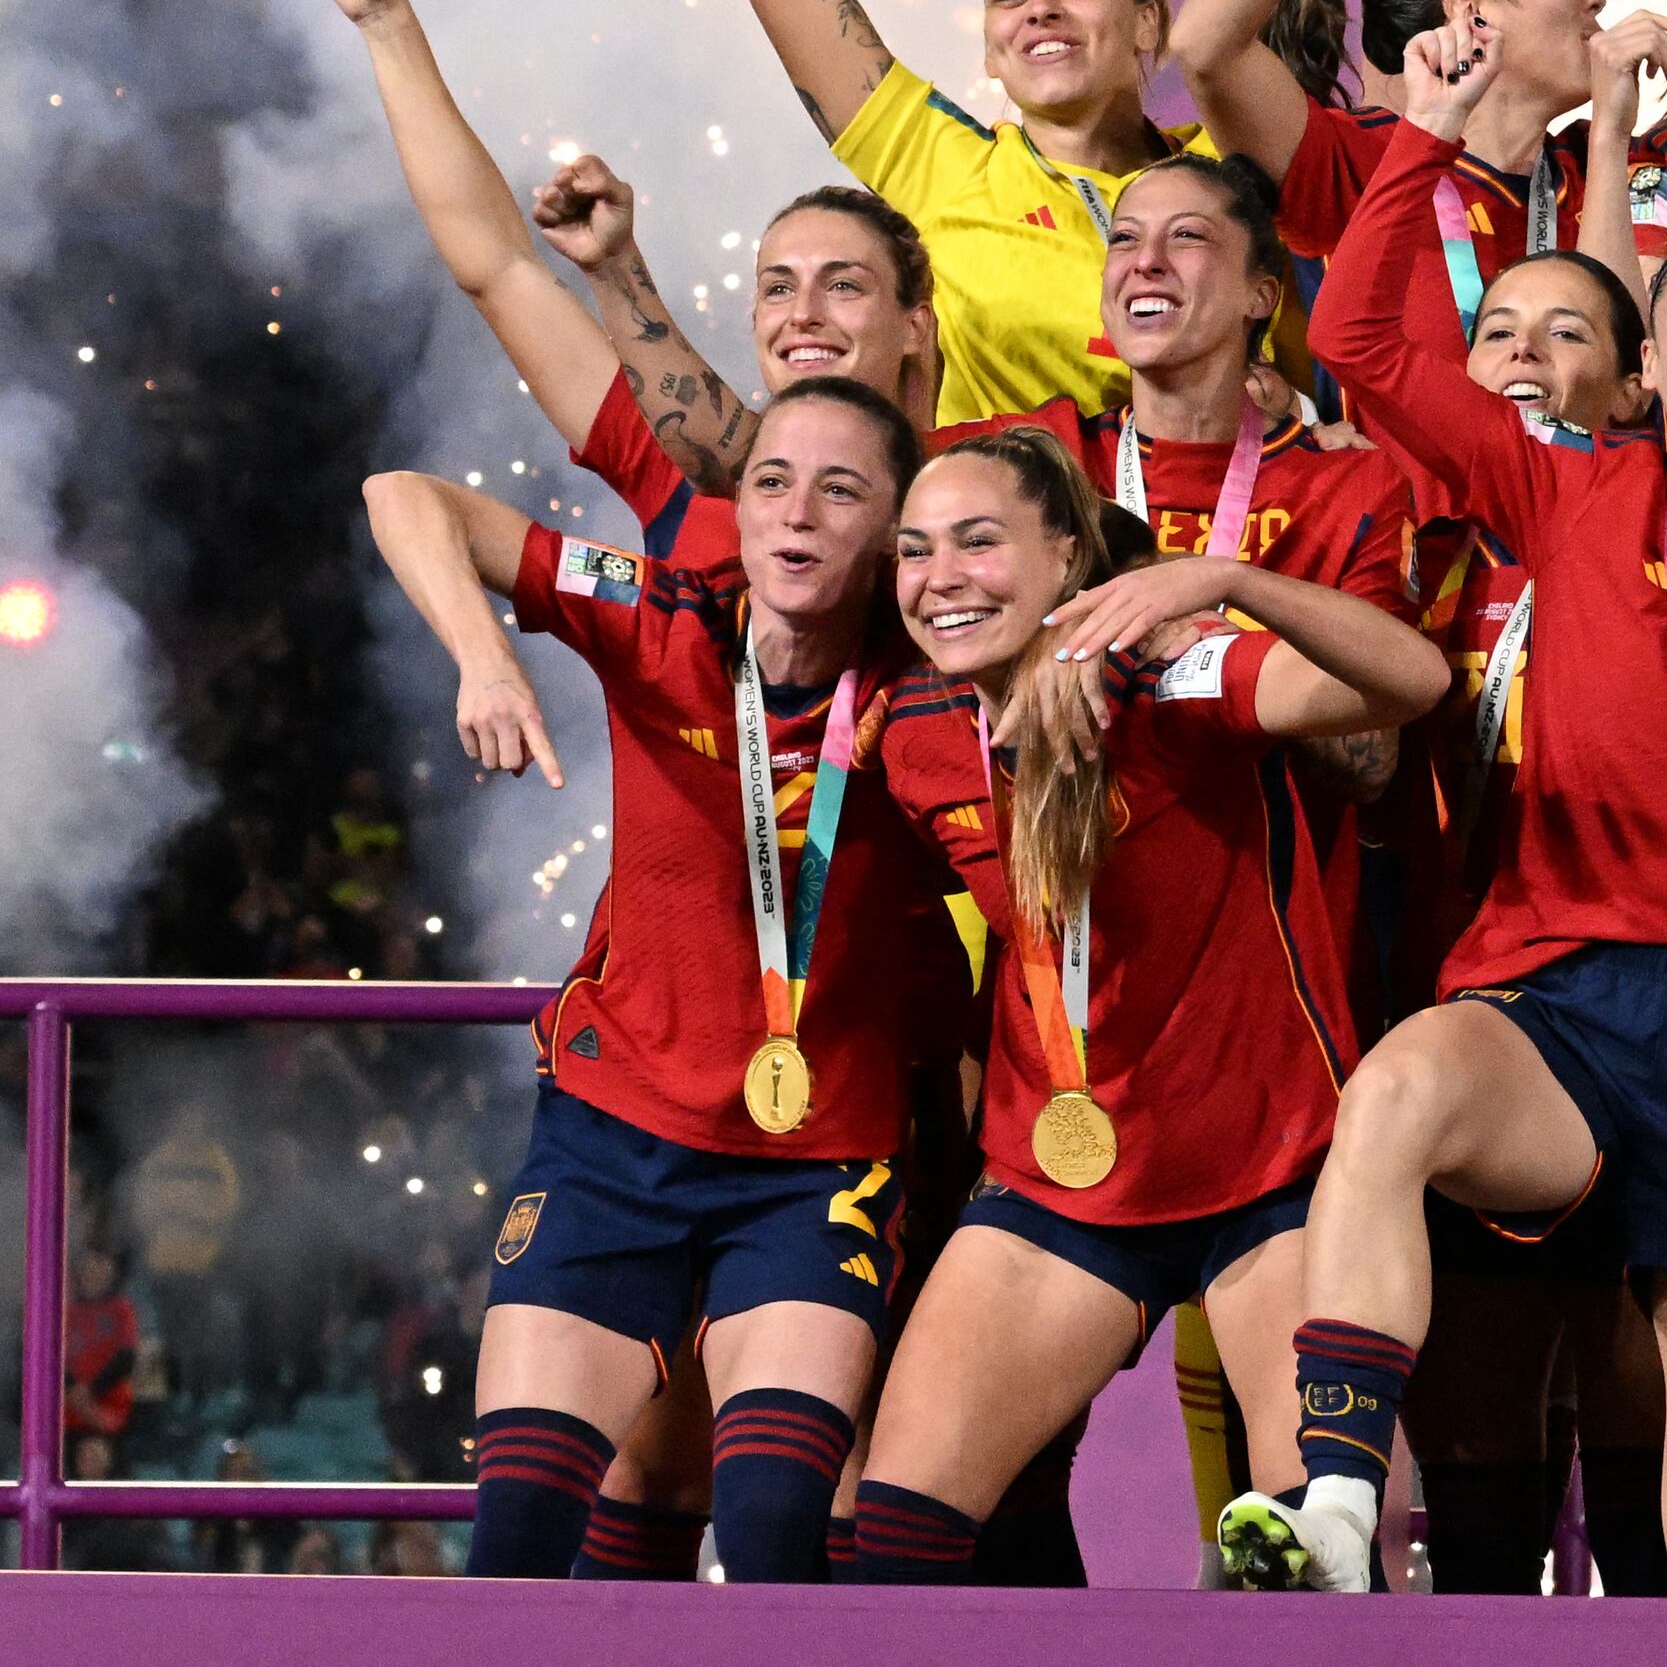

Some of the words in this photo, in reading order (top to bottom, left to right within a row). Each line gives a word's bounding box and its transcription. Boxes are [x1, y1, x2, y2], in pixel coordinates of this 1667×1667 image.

[1077, 178, 1096, 204] FIFA
[1536, 211, 1548, 253] WORLD
[1504, 601, 1531, 647] WORLD
[1497, 648, 1511, 675] CUP
[743, 655, 757, 726] WOMEN'S
[747, 727, 762, 782] WORLD
[751, 782, 767, 813] CUP
[1357, 1396, 1377, 1411] 09
